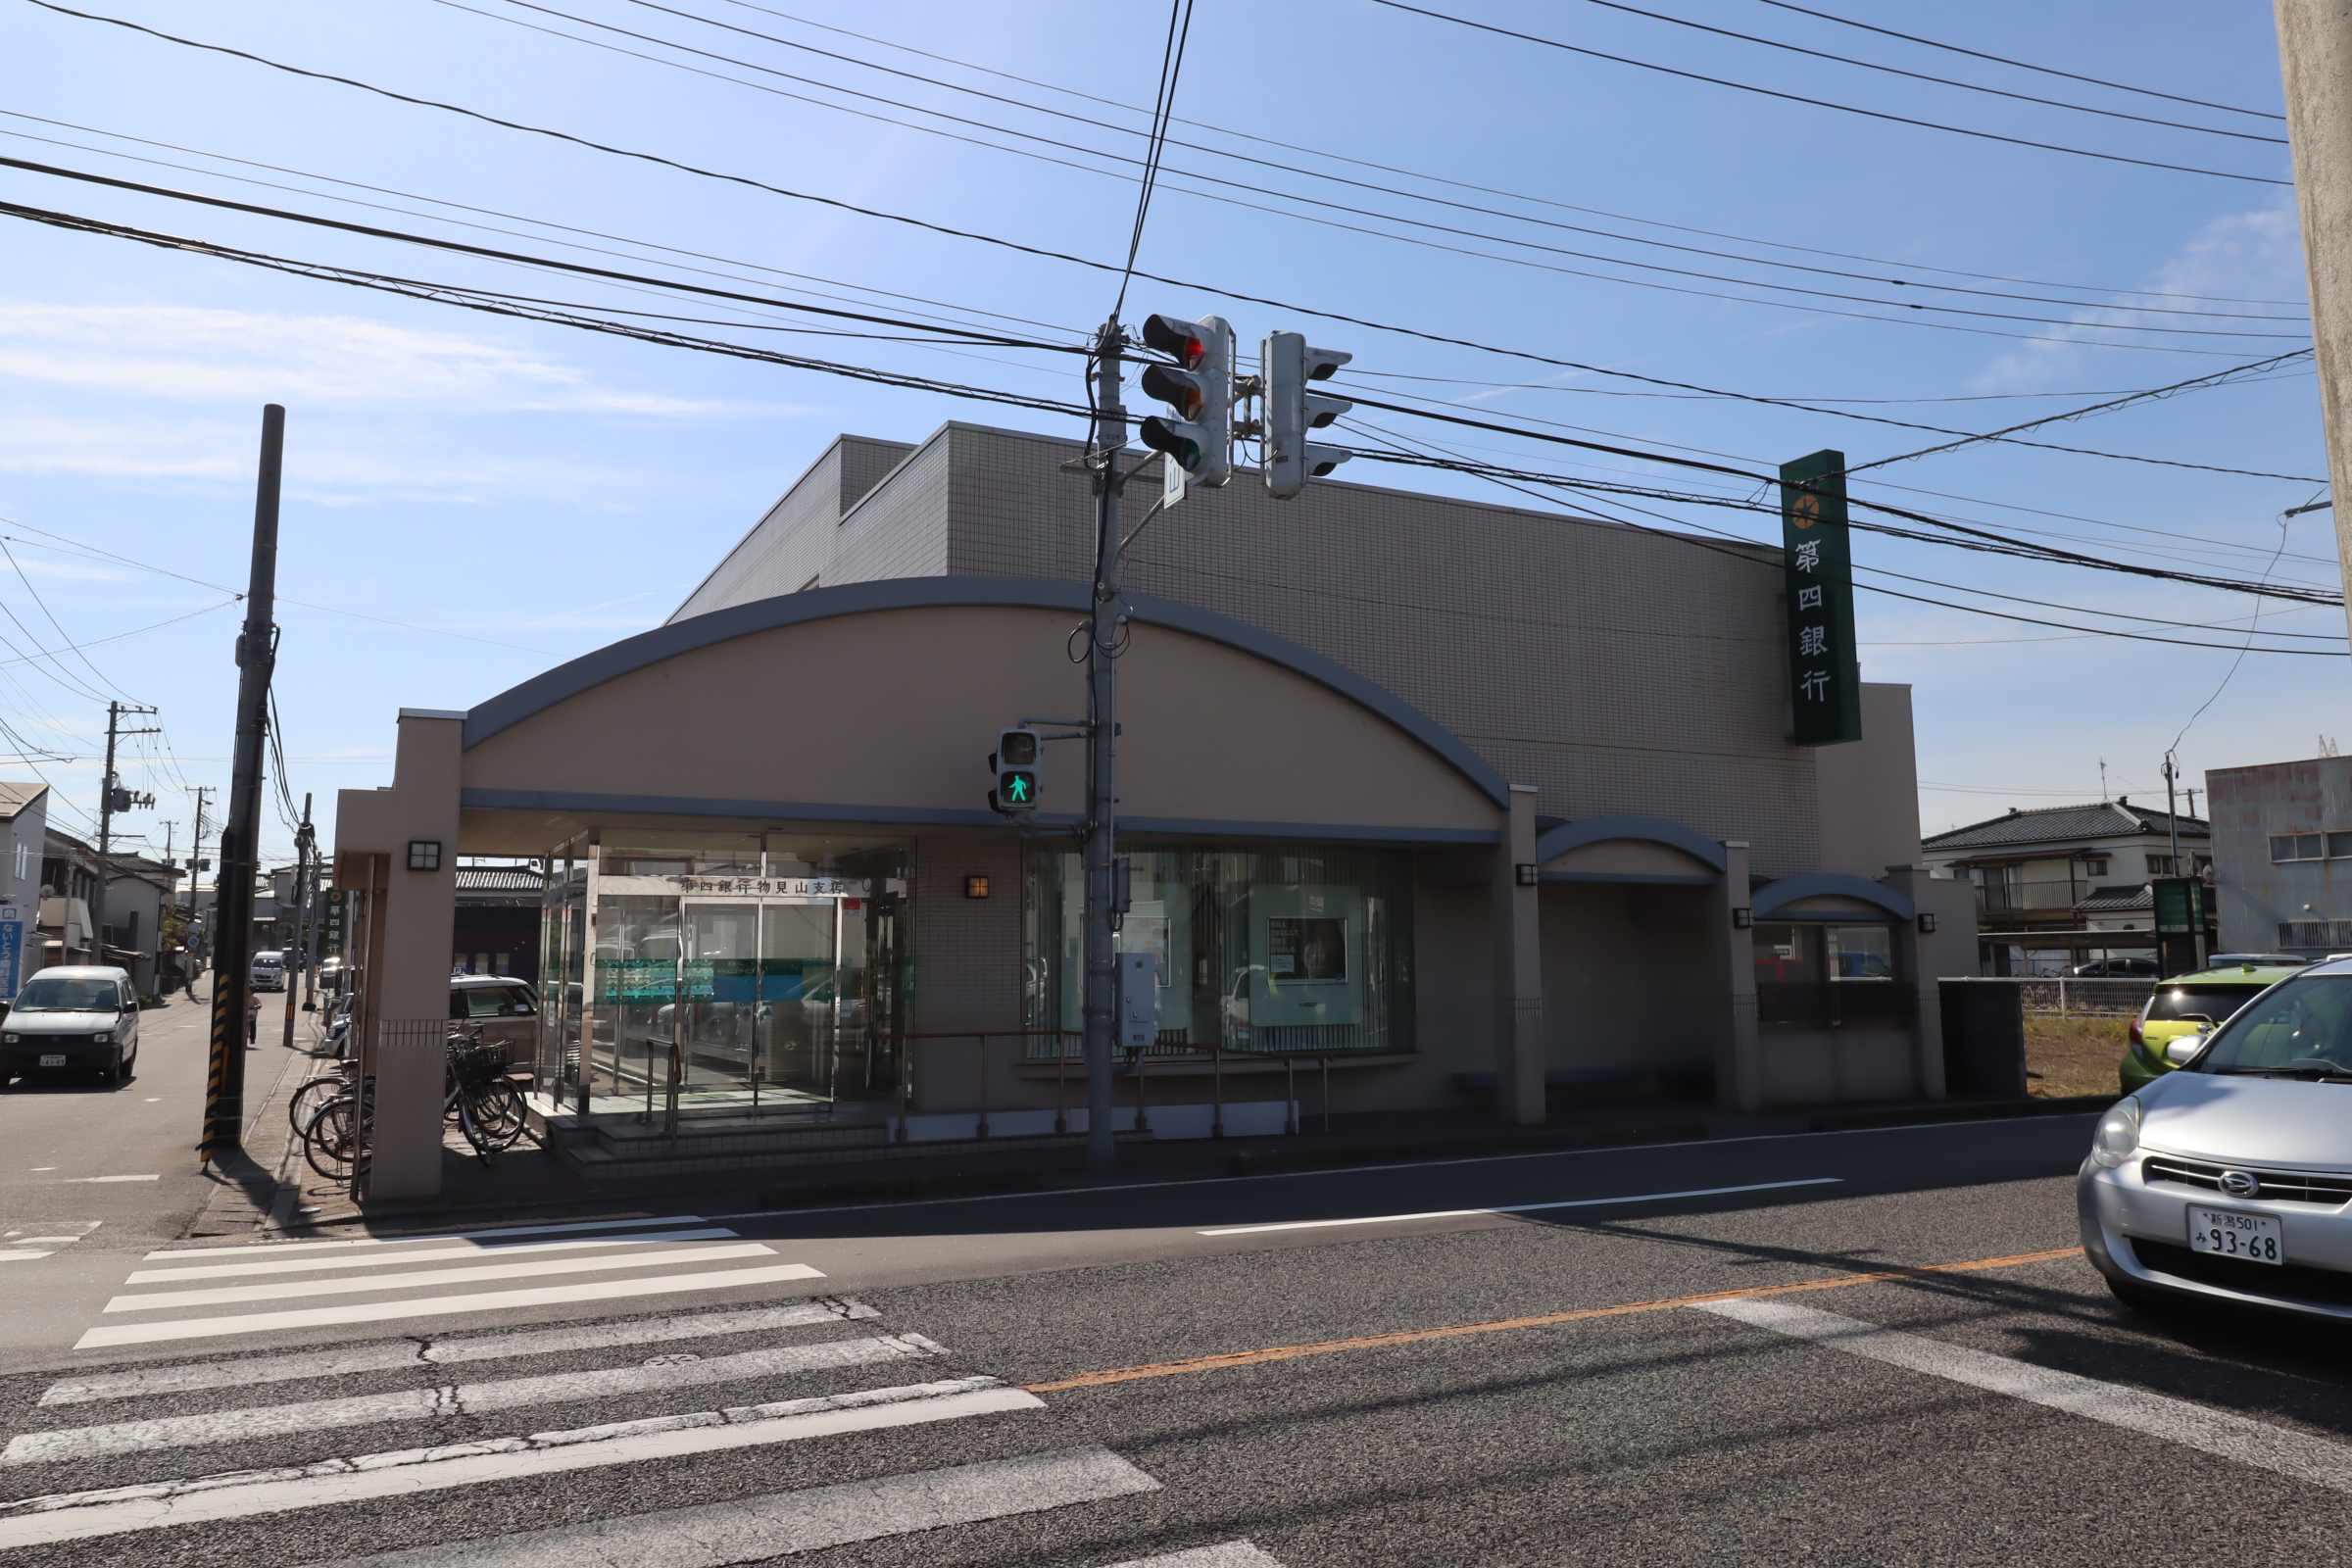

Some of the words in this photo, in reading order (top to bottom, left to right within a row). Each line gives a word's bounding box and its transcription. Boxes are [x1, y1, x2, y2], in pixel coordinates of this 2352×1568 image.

[1794, 539, 1831, 703] 第四銀行
[680, 879, 844, 894] 第四銀行物見山支店
[326, 905, 341, 954] 第四銀行
[2210, 1228, 2277, 1260] 93-68
